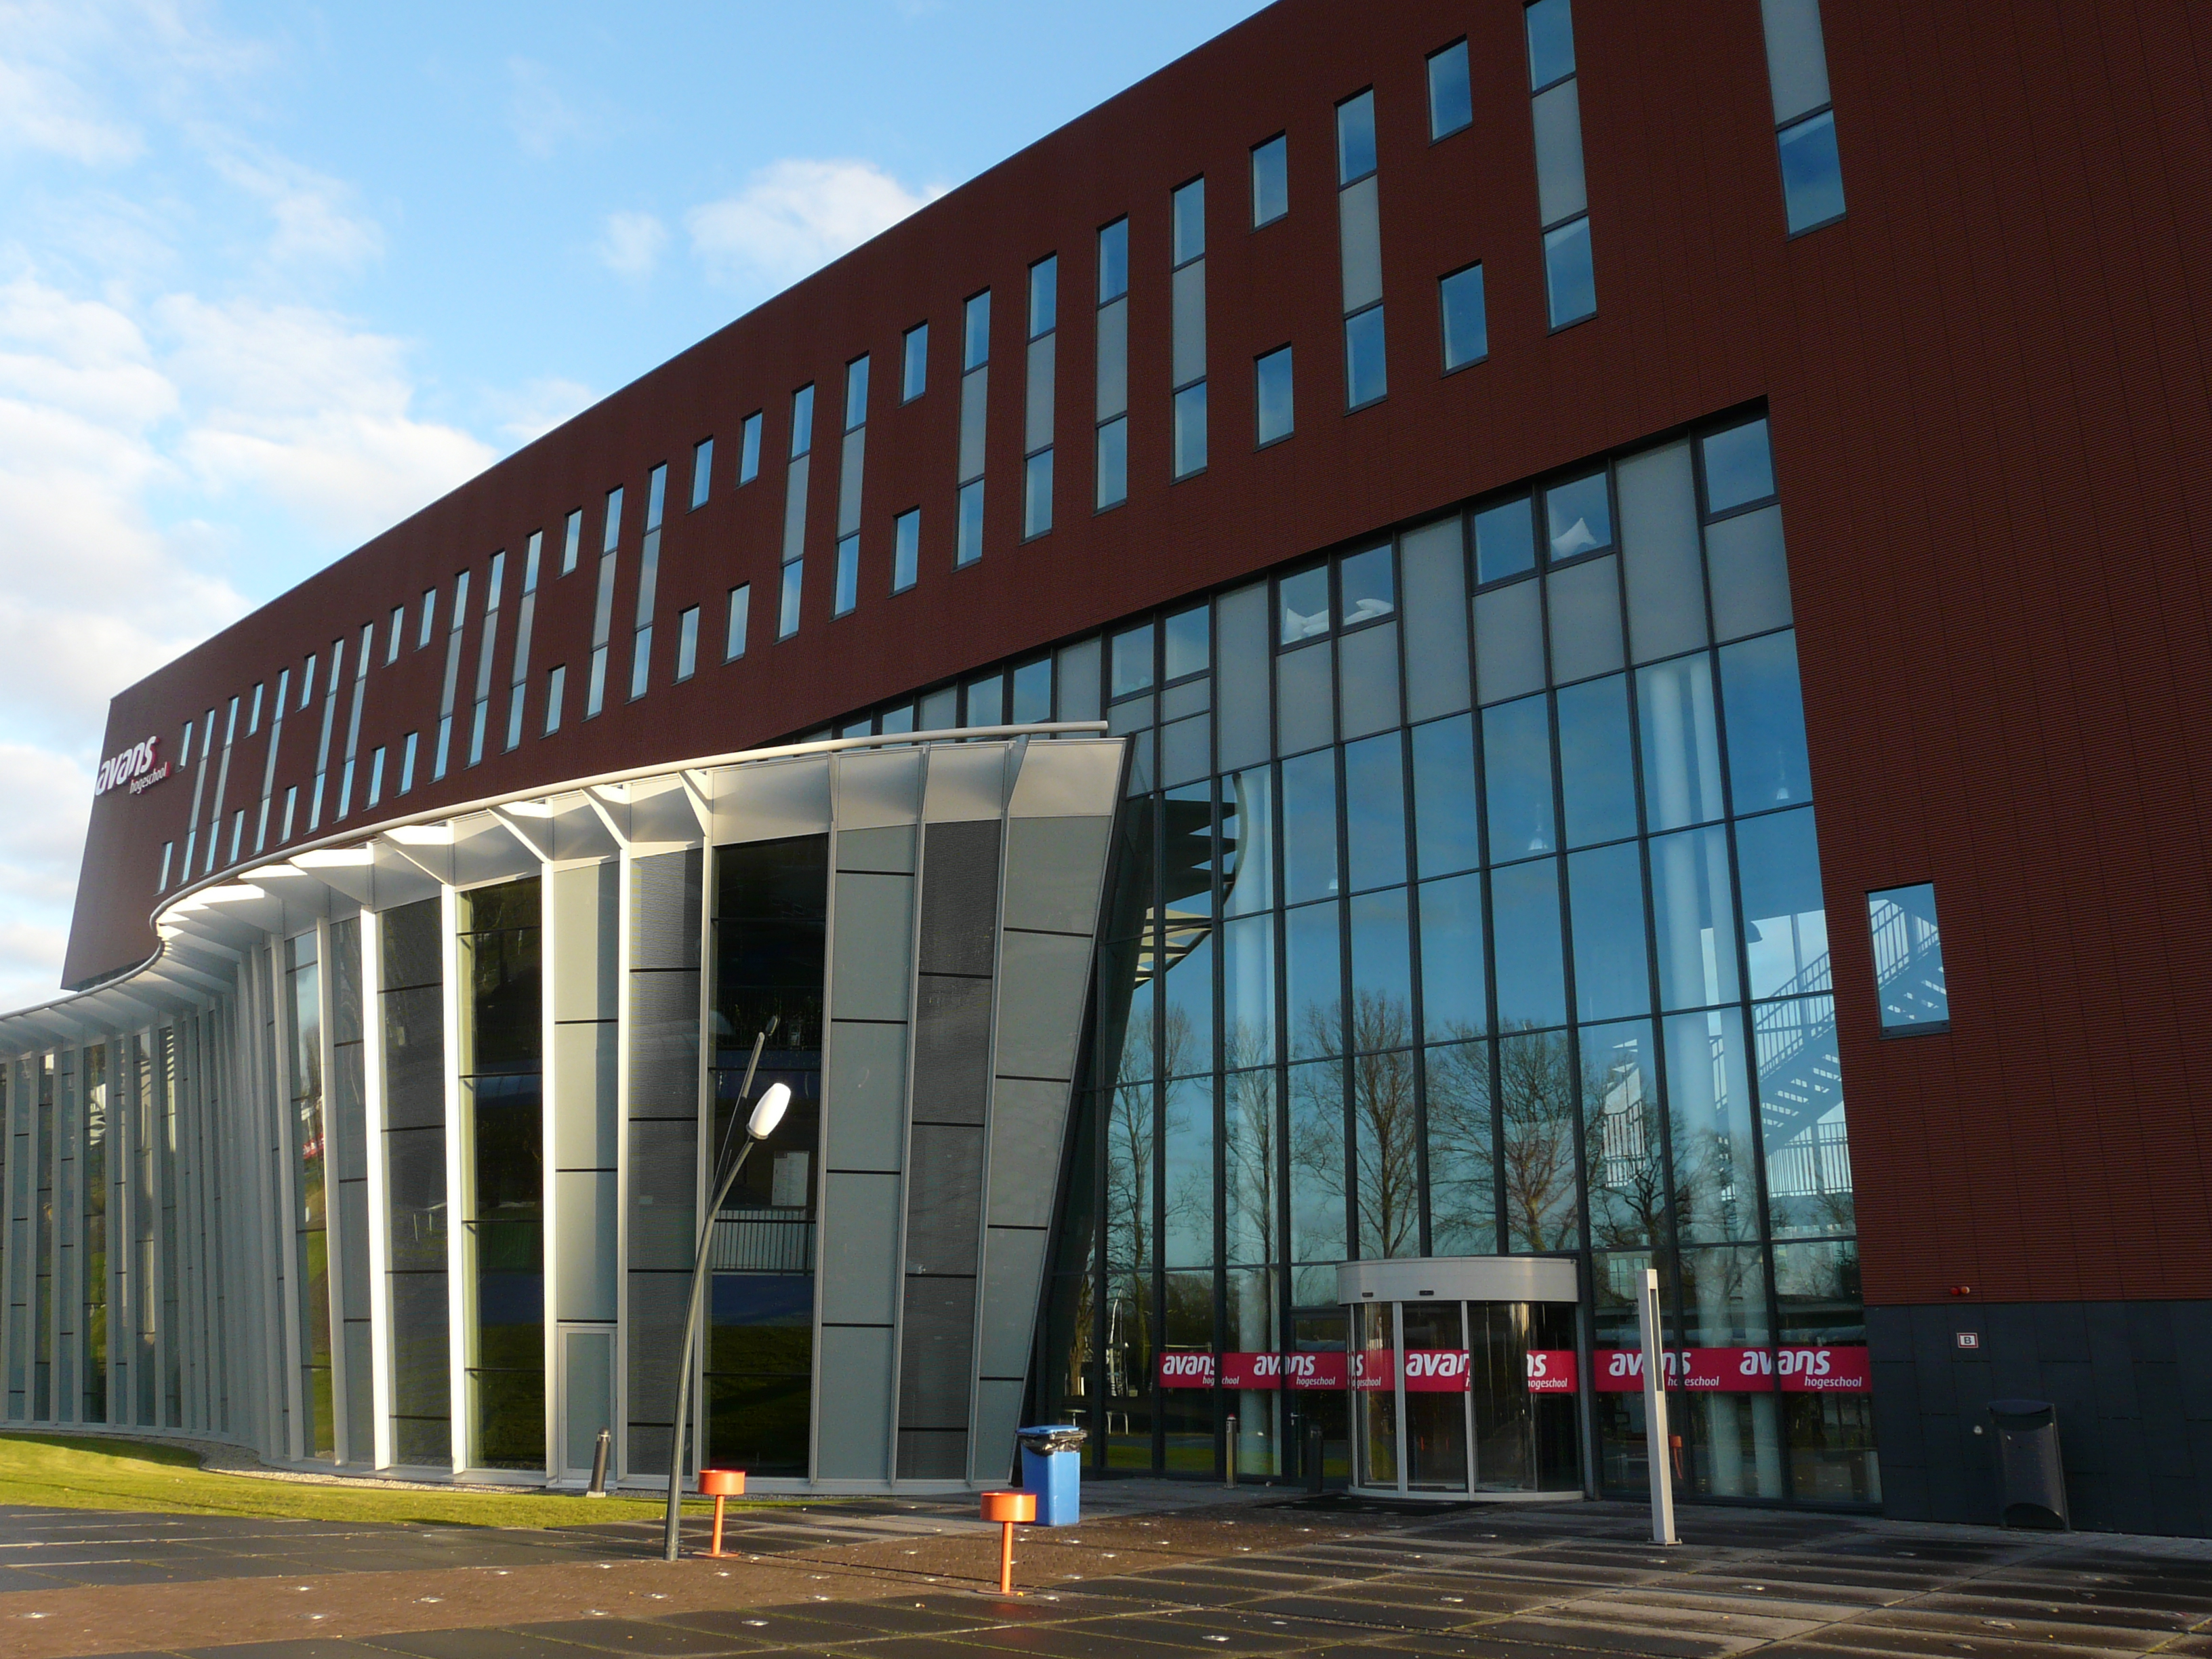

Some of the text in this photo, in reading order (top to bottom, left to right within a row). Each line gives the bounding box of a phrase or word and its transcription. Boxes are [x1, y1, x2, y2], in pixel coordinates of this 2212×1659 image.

[96, 736, 157, 796] avans
[129, 761, 167, 794] hogeschool
[1609, 1352, 1692, 1376] avns
[1740, 1350, 1831, 1375] avans
[1202, 1376, 1240, 1387] hogchool
[1296, 1376, 1336, 1387] hogeschool
[1668, 1376, 1719, 1387] hoeschool
[1805, 1376, 1862, 1389] hogeschool
